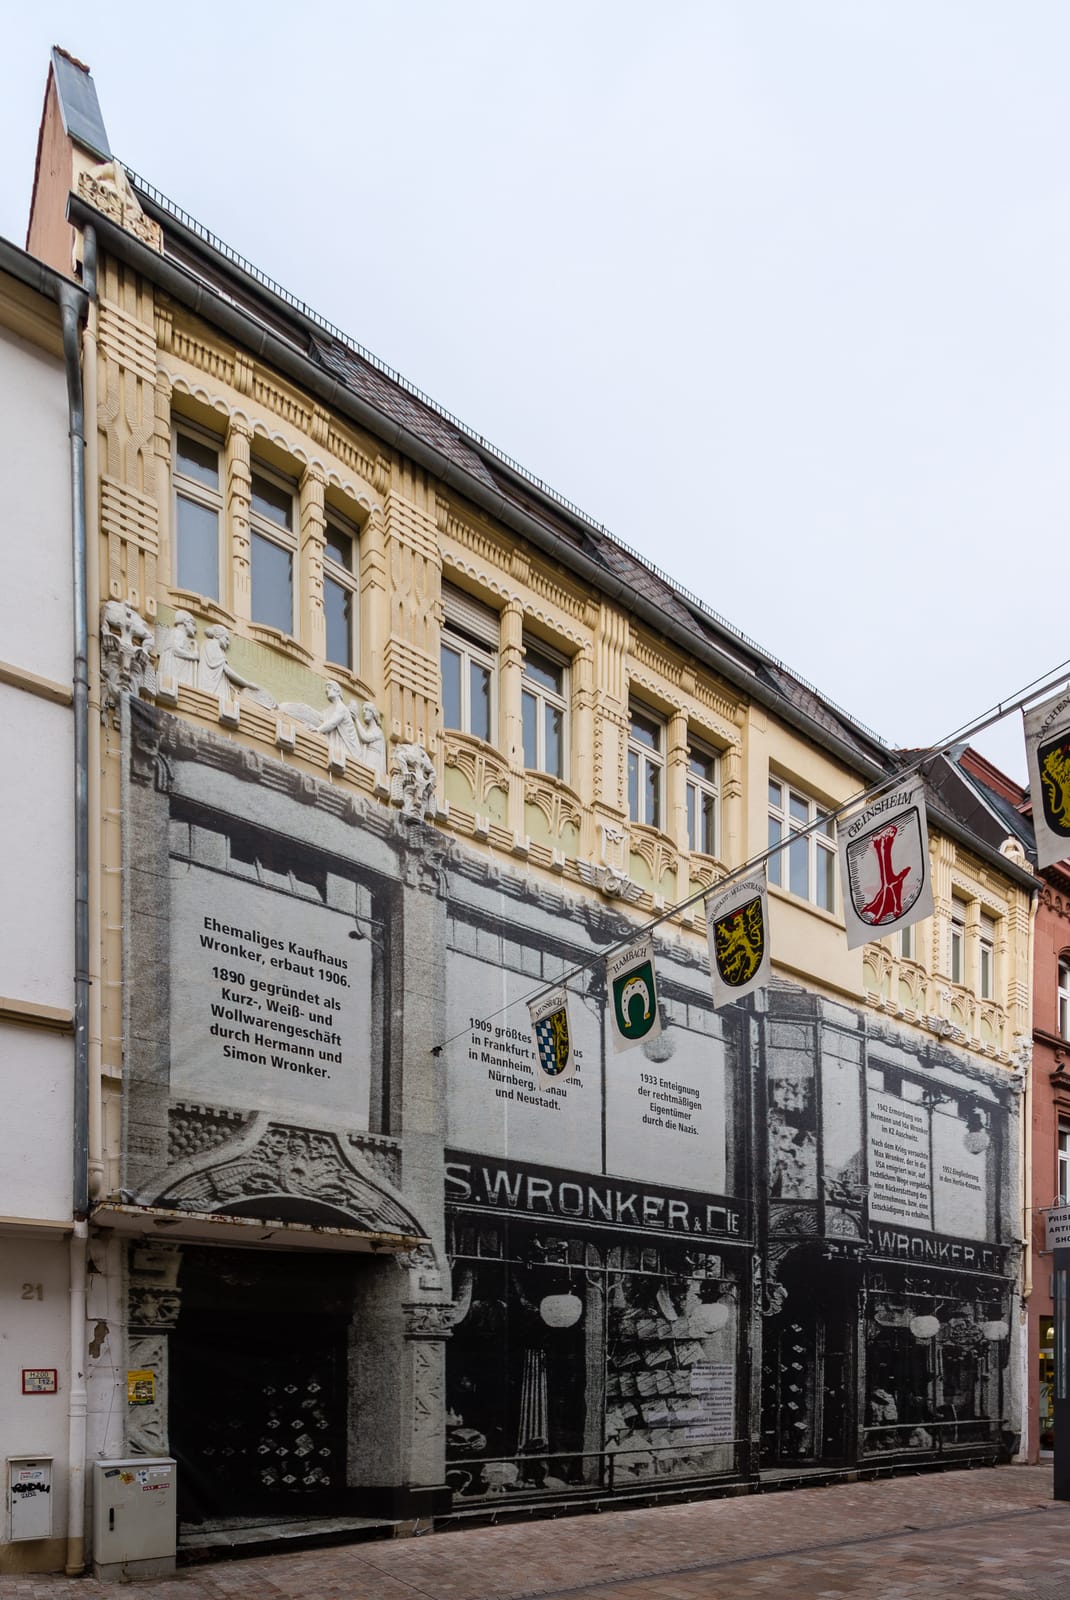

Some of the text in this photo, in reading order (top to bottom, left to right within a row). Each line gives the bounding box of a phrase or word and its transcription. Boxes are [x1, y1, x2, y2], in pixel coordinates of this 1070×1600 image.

[848, 791, 913, 838] GEINSHEIM
[204, 916, 348, 969] Ehemaliges Kaufhaus
[200, 934, 350, 988] Wronker, erbaut 1906.
[612, 948, 647, 973] HAMBACH
[212, 966, 341, 1011] 1890 gegründet als
[222, 988, 333, 1026] Kurz-, Weiß- und
[211, 1004, 342, 1046] Wollwarengeschäft
[470, 1018, 532, 1044] 1909 größtes
[210, 1023, 342, 1064] durch Hermann und
[472, 1033, 480, 1045] in
[484, 1037, 529, 1058] Frankfurt
[223, 1045, 331, 1078] Simon Wronker.
[469, 1048, 477, 1060] in
[481, 1052, 534, 1075] Mannheim,
[488, 1070, 567, 1097] Nürnberg, anau
[640, 1073, 700, 1098] 1933 Enteignung
[496, 1089, 560, 1110] und Neustadt.
[638, 1086, 702, 1110] der rechtmäßigen
[650, 1102, 692, 1120] Eigentümer
[889, 1107, 913, 1122] Ermordung
[642, 1114, 699, 1135] durch die Nazis.
[871, 1112, 891, 1123] Hermann
[910, 1124, 928, 1135] Wronker
[889, 1127, 894, 1135] KZ
[871, 1138, 883, 1147] Nach
[884, 1141, 894, 1150] dem
[895, 1144, 907, 1155] Krieg
[874, 1149, 884, 1158] Max
[876, 1160, 885, 1168] USA
[886, 1184, 918, 1199] Rückerstattung
[872, 1202, 904, 1216] Entschädigung
[693, 1217, 702, 1232] &
[21, 1283, 44, 1301] 21
